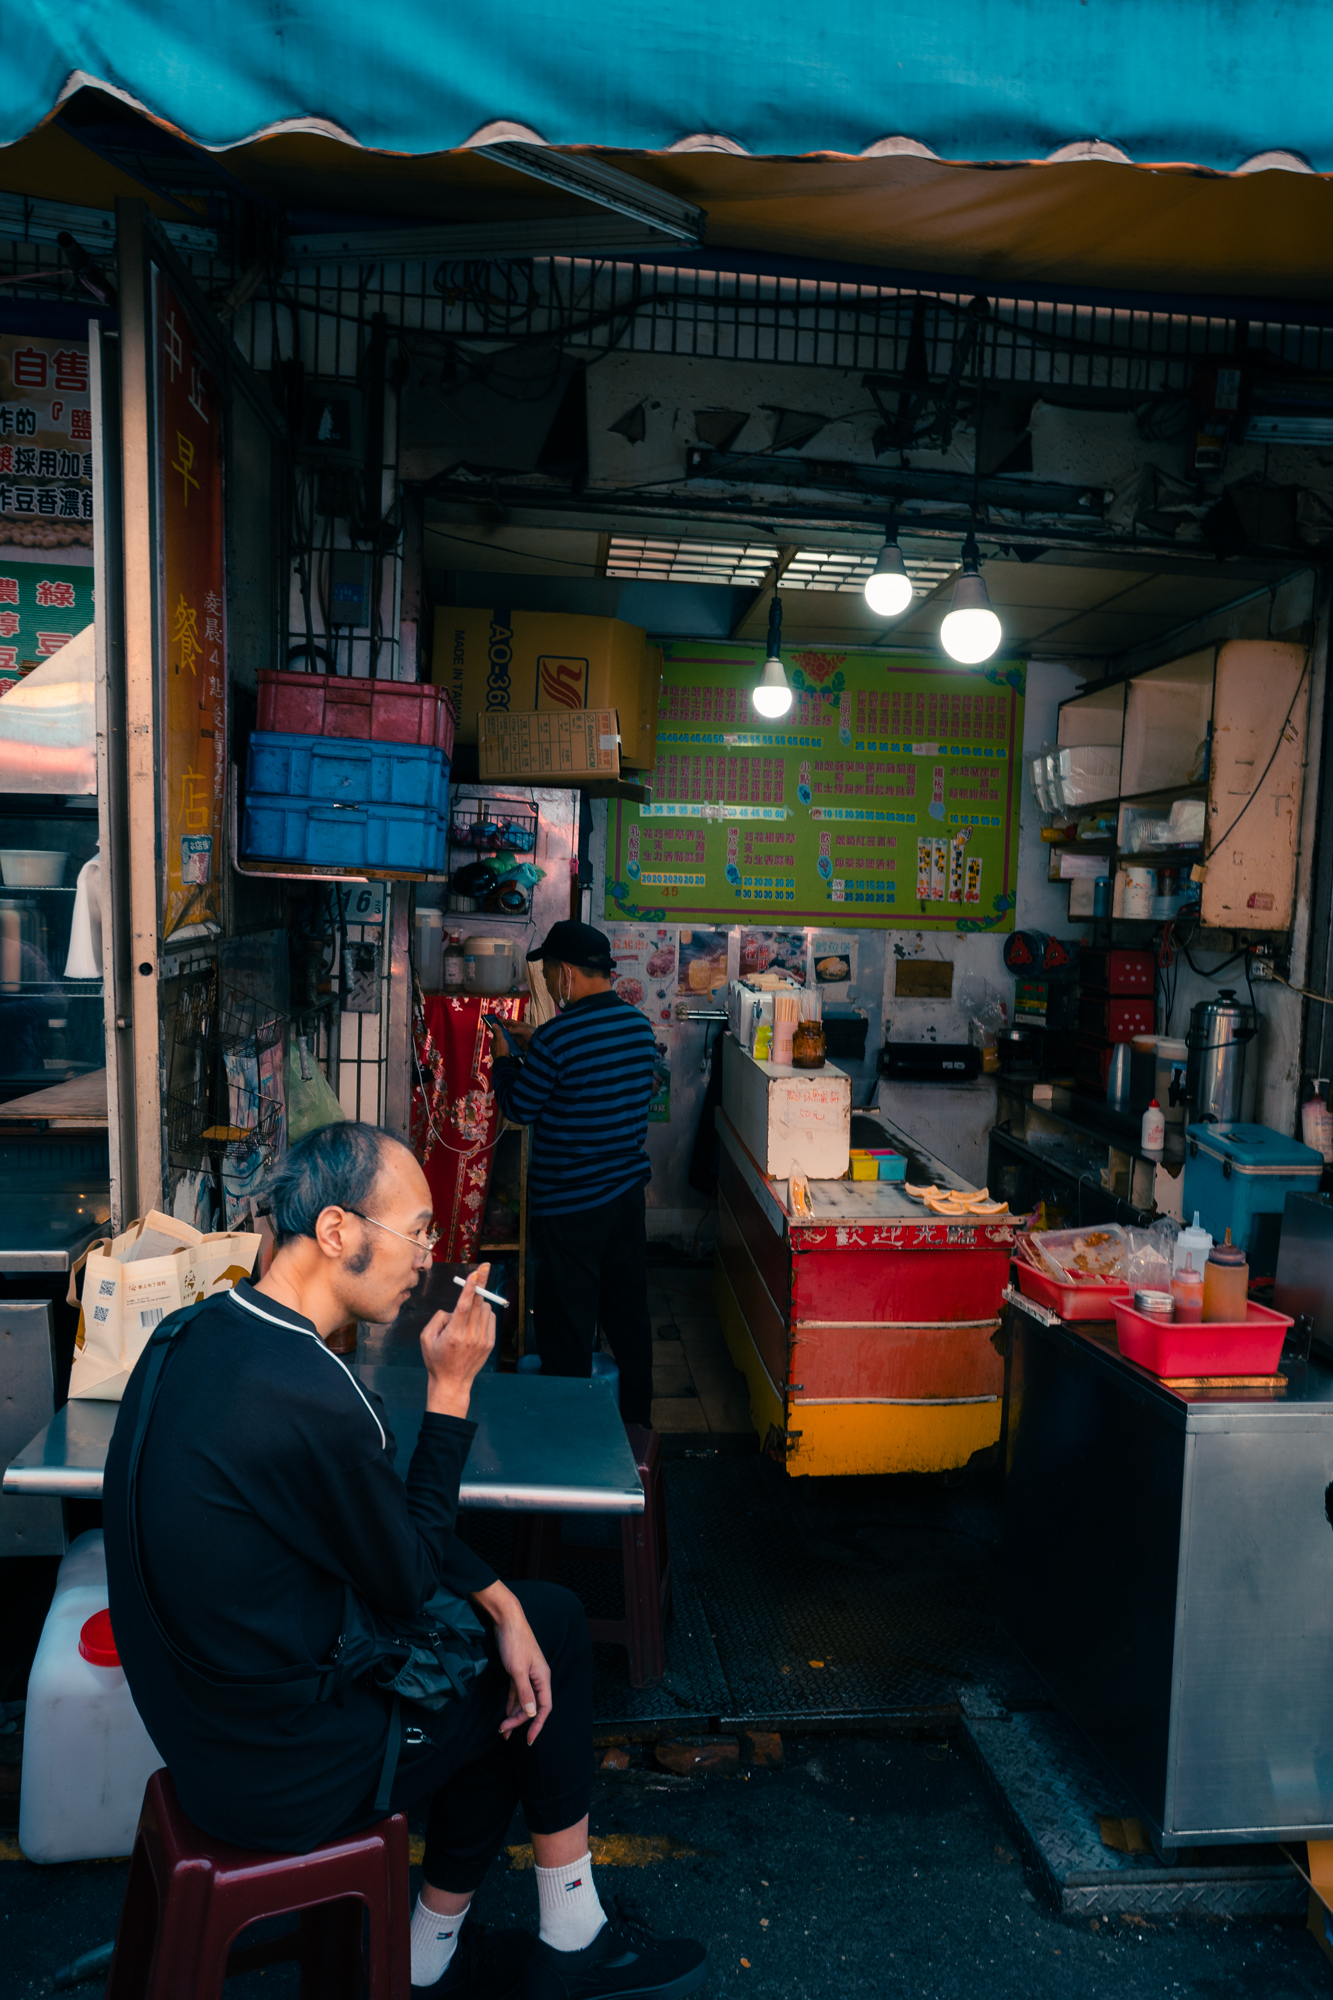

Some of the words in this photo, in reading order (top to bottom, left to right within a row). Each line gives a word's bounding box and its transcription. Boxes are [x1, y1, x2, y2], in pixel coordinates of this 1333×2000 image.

[454, 629, 466, 665] MADE
[453, 668, 463, 680] IN
[840, 691, 852, 729] 三明治
[799, 760, 812, 786] 小點
[739, 808, 749, 818] 45
[751, 808, 761, 818] 45
[763, 809, 774, 819] 60
[775, 809, 786, 820] 60
[823, 809, 833, 819] 10
[834, 809, 844, 820] 15
[845, 810, 855, 820] 20
[627, 825, 640, 862] 乳酪餅
[643, 828, 654, 862] 花生
[654, 828, 664, 862] 巧克力
[744, 832, 754, 866] 巧克力
[755, 832, 765, 866] 花生
[819, 831, 832, 857] 飲品
[856, 835, 867, 870] 紅茶
[642, 874, 651, 884] 20
[652, 874, 662, 884] 20
[663, 874, 673, 884] 20
[674, 875, 684, 885] 20
[684, 875, 694, 885] 20
[695, 875, 705, 885] 20
[744, 877, 753, 886] 20
[754, 877, 763, 887] 20
[764, 878, 773, 887] 20
[775, 878, 784, 888] 20
[785, 878, 795, 889] 20
[743, 889, 752, 899] 30
[754, 889, 763, 899] 30
[764, 890, 773, 899] 30
[775, 890, 784, 900] 30
[785, 891, 795, 900] 30
[835, 1225, 978, 1247] 歡迎光臨
